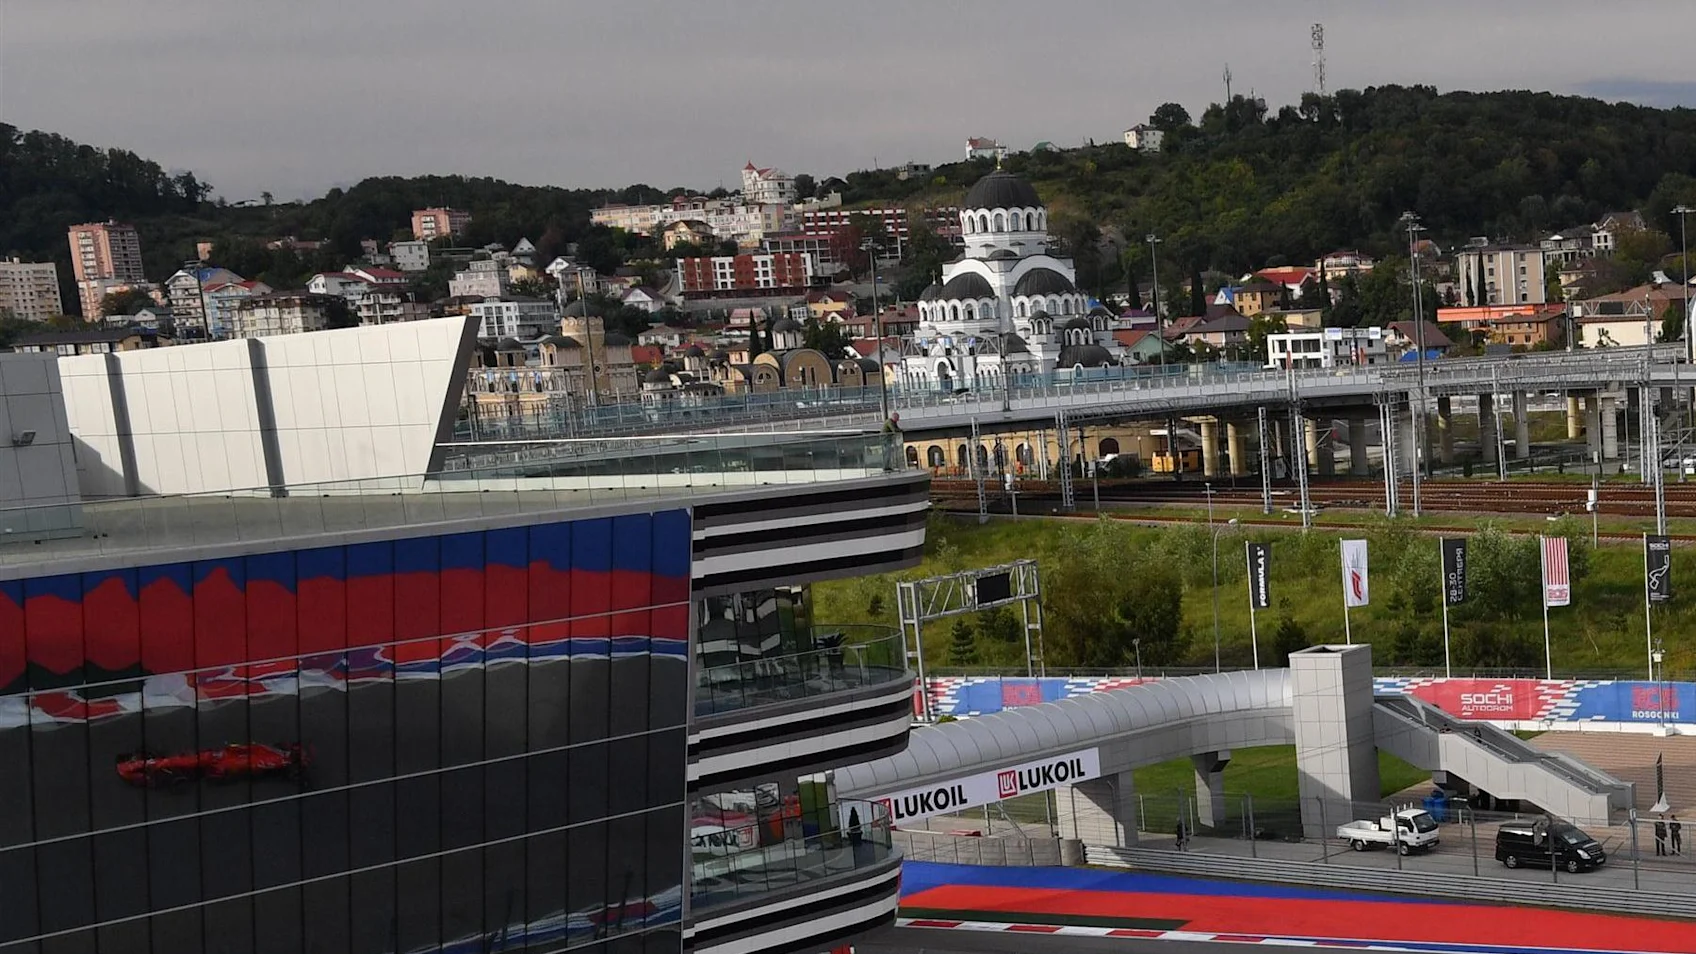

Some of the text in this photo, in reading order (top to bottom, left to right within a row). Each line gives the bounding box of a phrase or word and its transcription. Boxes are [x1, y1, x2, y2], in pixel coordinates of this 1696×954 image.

[1449, 572, 1458, 603] 28-30
[1461, 693, 1513, 704] SOCHI
[1632, 710, 1679, 719] ROSGONKI
[1018, 758, 1086, 791] LUKOIL
[893, 785, 968, 819] LUKOIL
